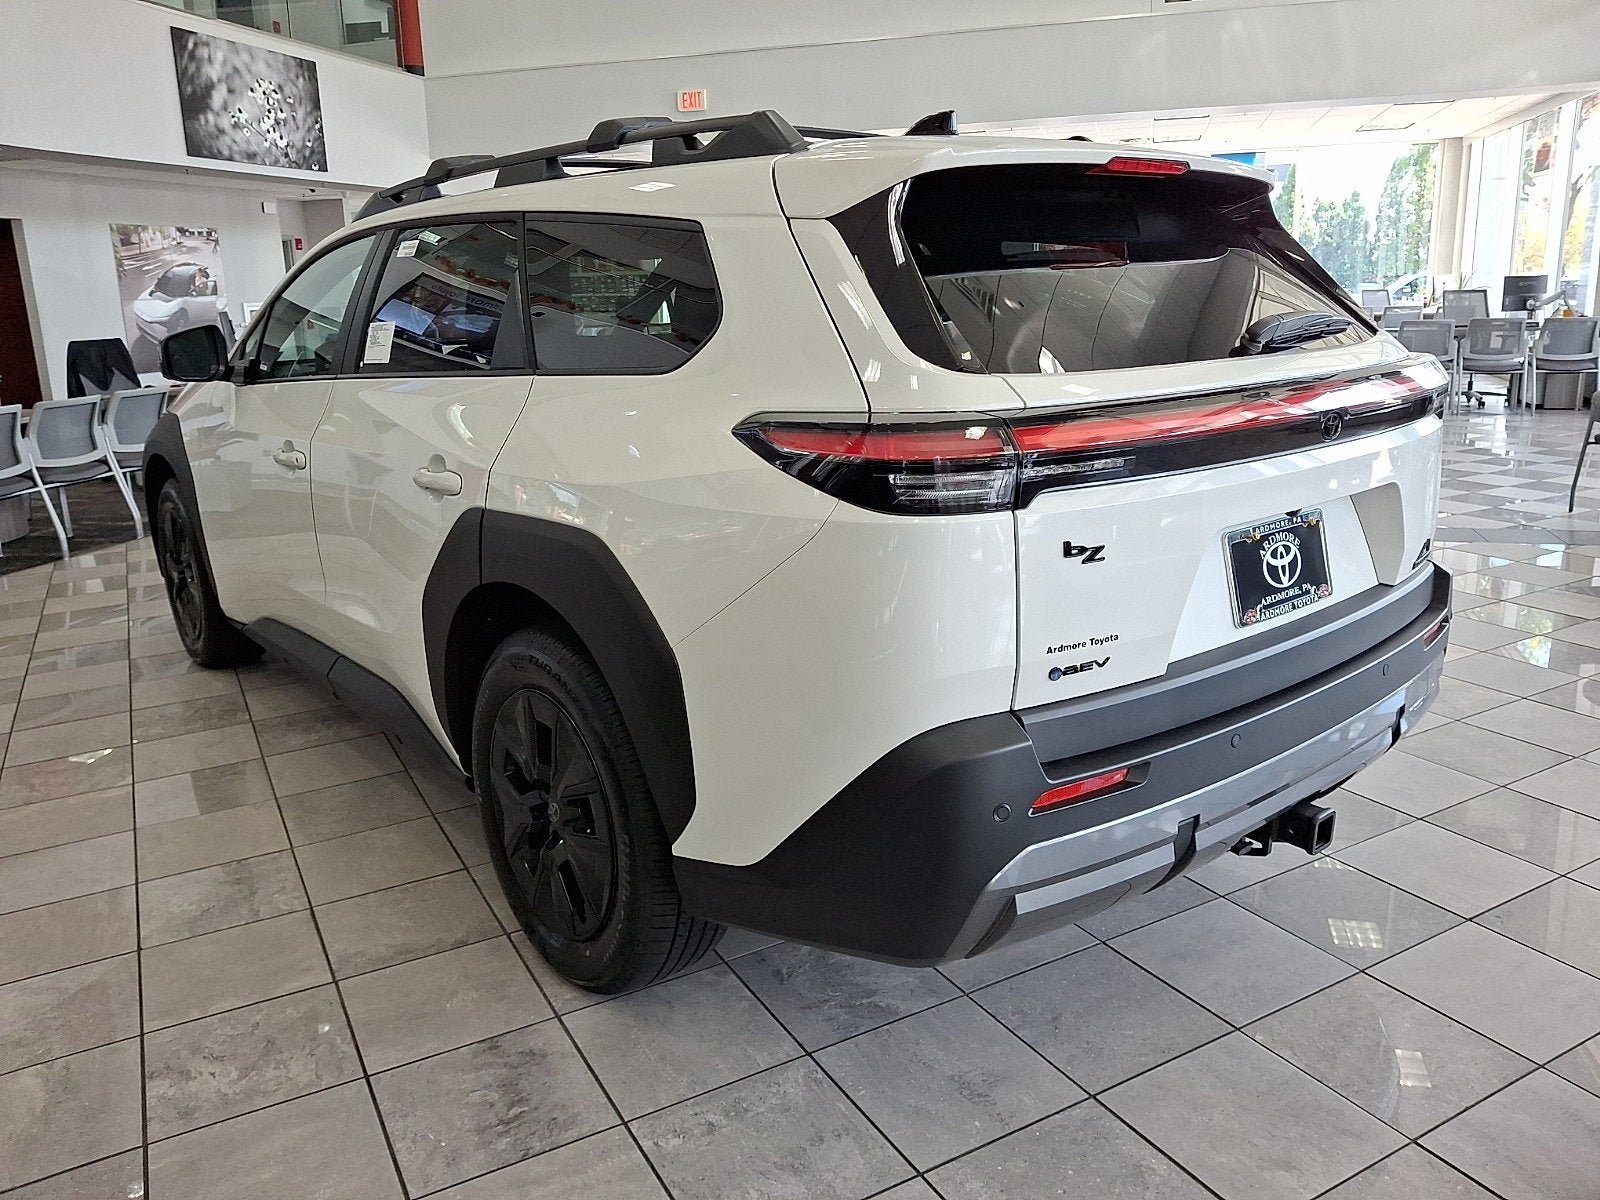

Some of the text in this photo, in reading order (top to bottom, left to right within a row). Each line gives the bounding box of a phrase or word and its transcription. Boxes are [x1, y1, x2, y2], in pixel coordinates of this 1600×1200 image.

[682, 91, 702, 109] EXIT
[1293, 516, 1302, 526] PA
[1259, 531, 1301, 560] ARDMORE
[1302, 582, 1313, 593] PA
[1260, 594, 1319, 621] ARDMORE TOYOTA
[1046, 633, 1119, 655] Ardmore Toyota
[1062, 656, 1111, 677] BEV
